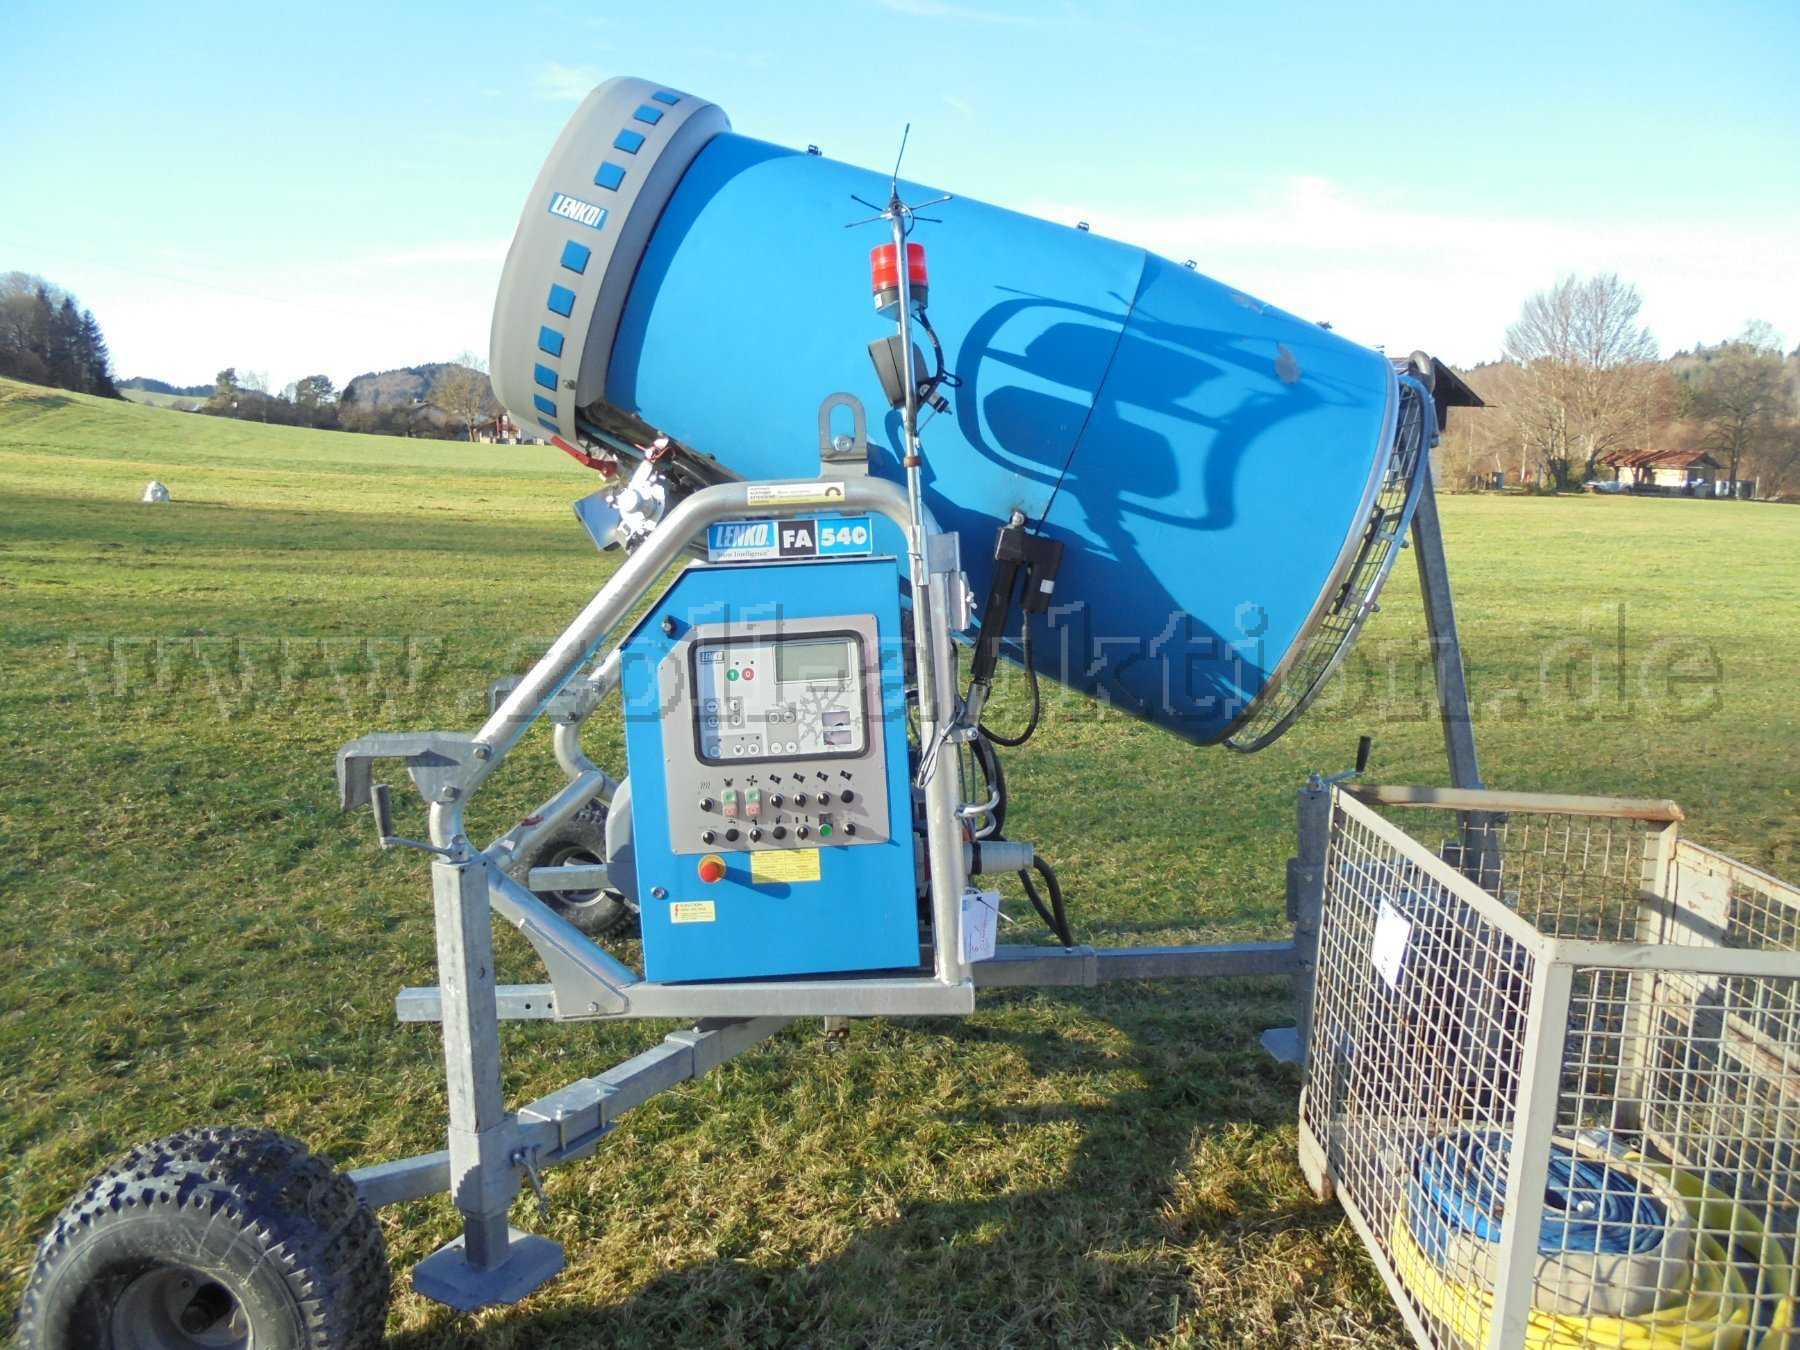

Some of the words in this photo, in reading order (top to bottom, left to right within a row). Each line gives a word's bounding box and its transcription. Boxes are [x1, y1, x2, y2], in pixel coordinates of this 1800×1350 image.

[715, 523, 769, 548] LENKO
[783, 529, 813, 549] FA
[821, 526, 868, 547] 540
